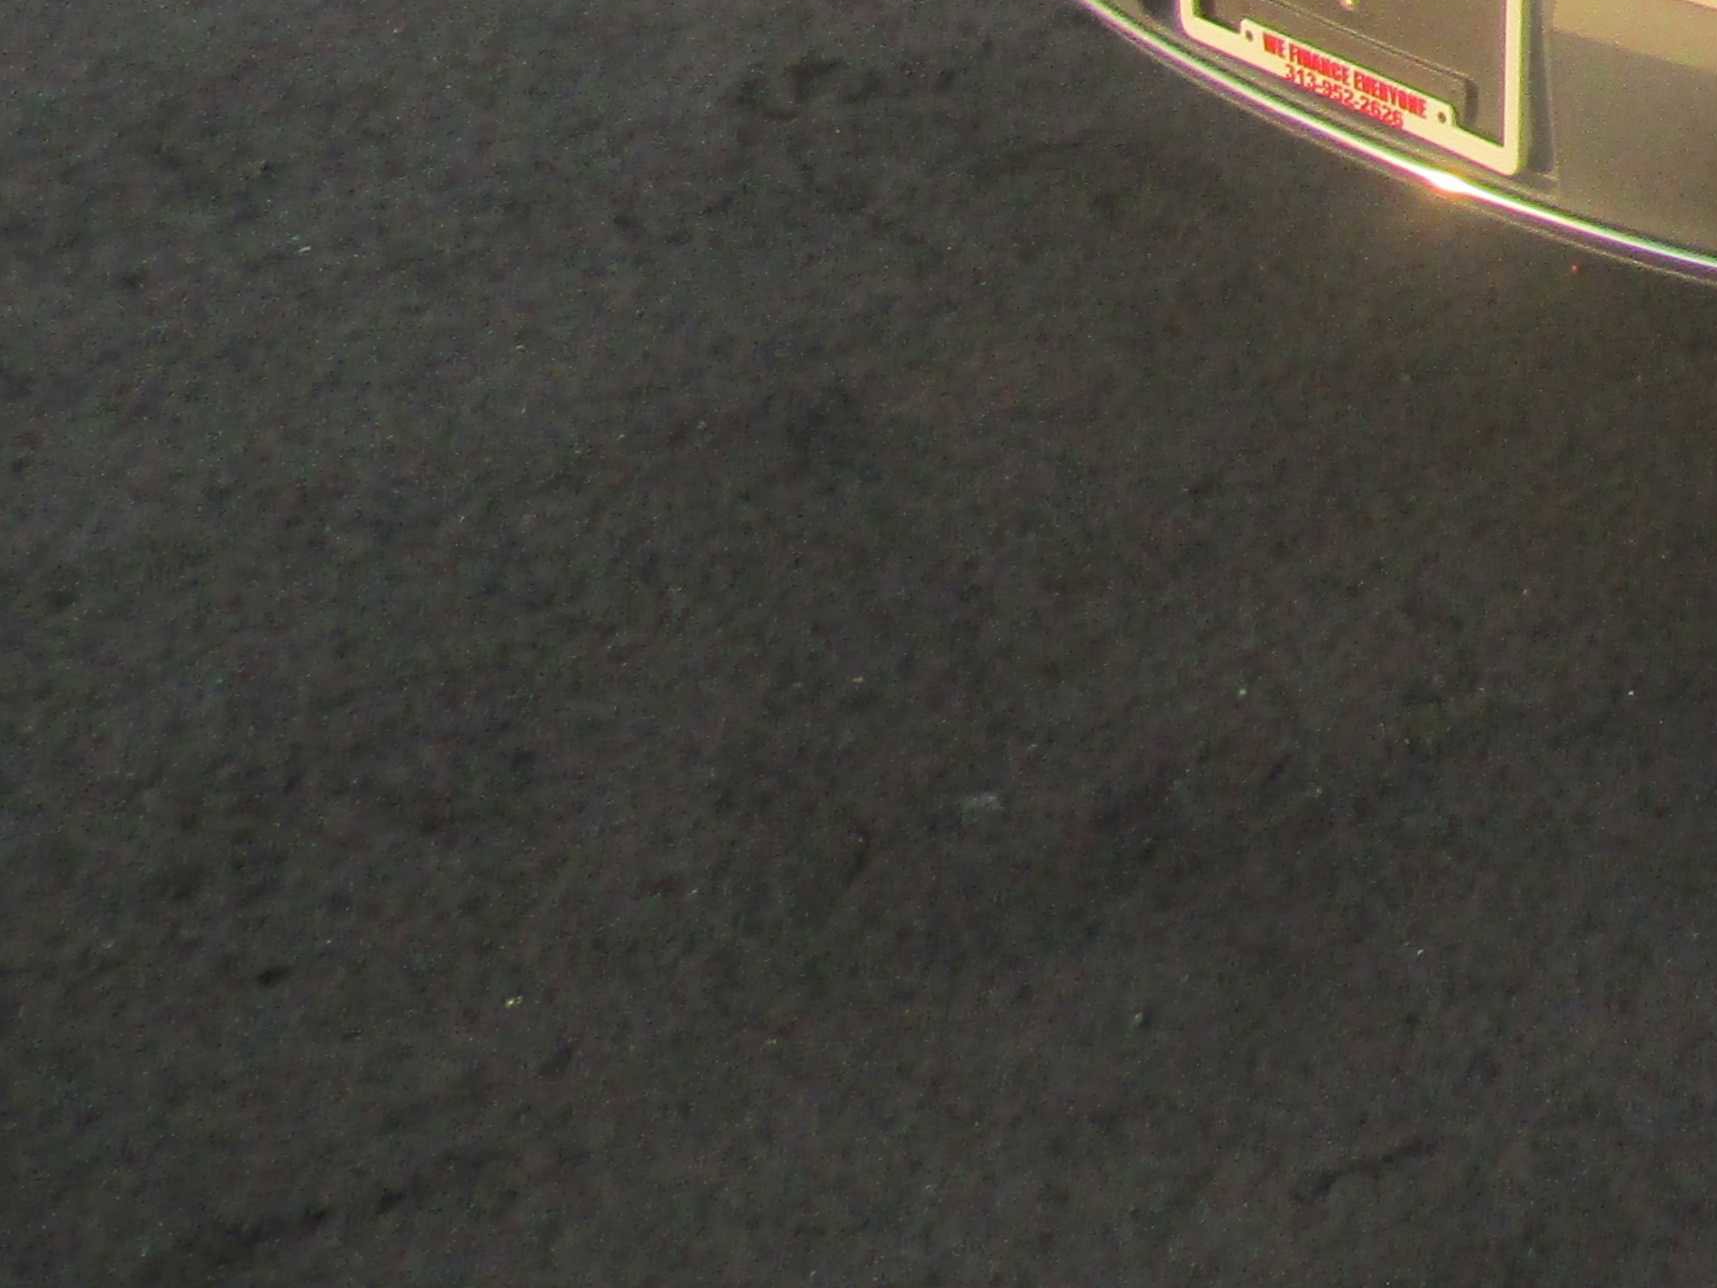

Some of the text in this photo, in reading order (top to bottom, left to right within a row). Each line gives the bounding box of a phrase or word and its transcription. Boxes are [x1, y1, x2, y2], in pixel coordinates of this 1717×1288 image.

[1263, 32, 1428, 120] WE FINANCE EVERYONE
